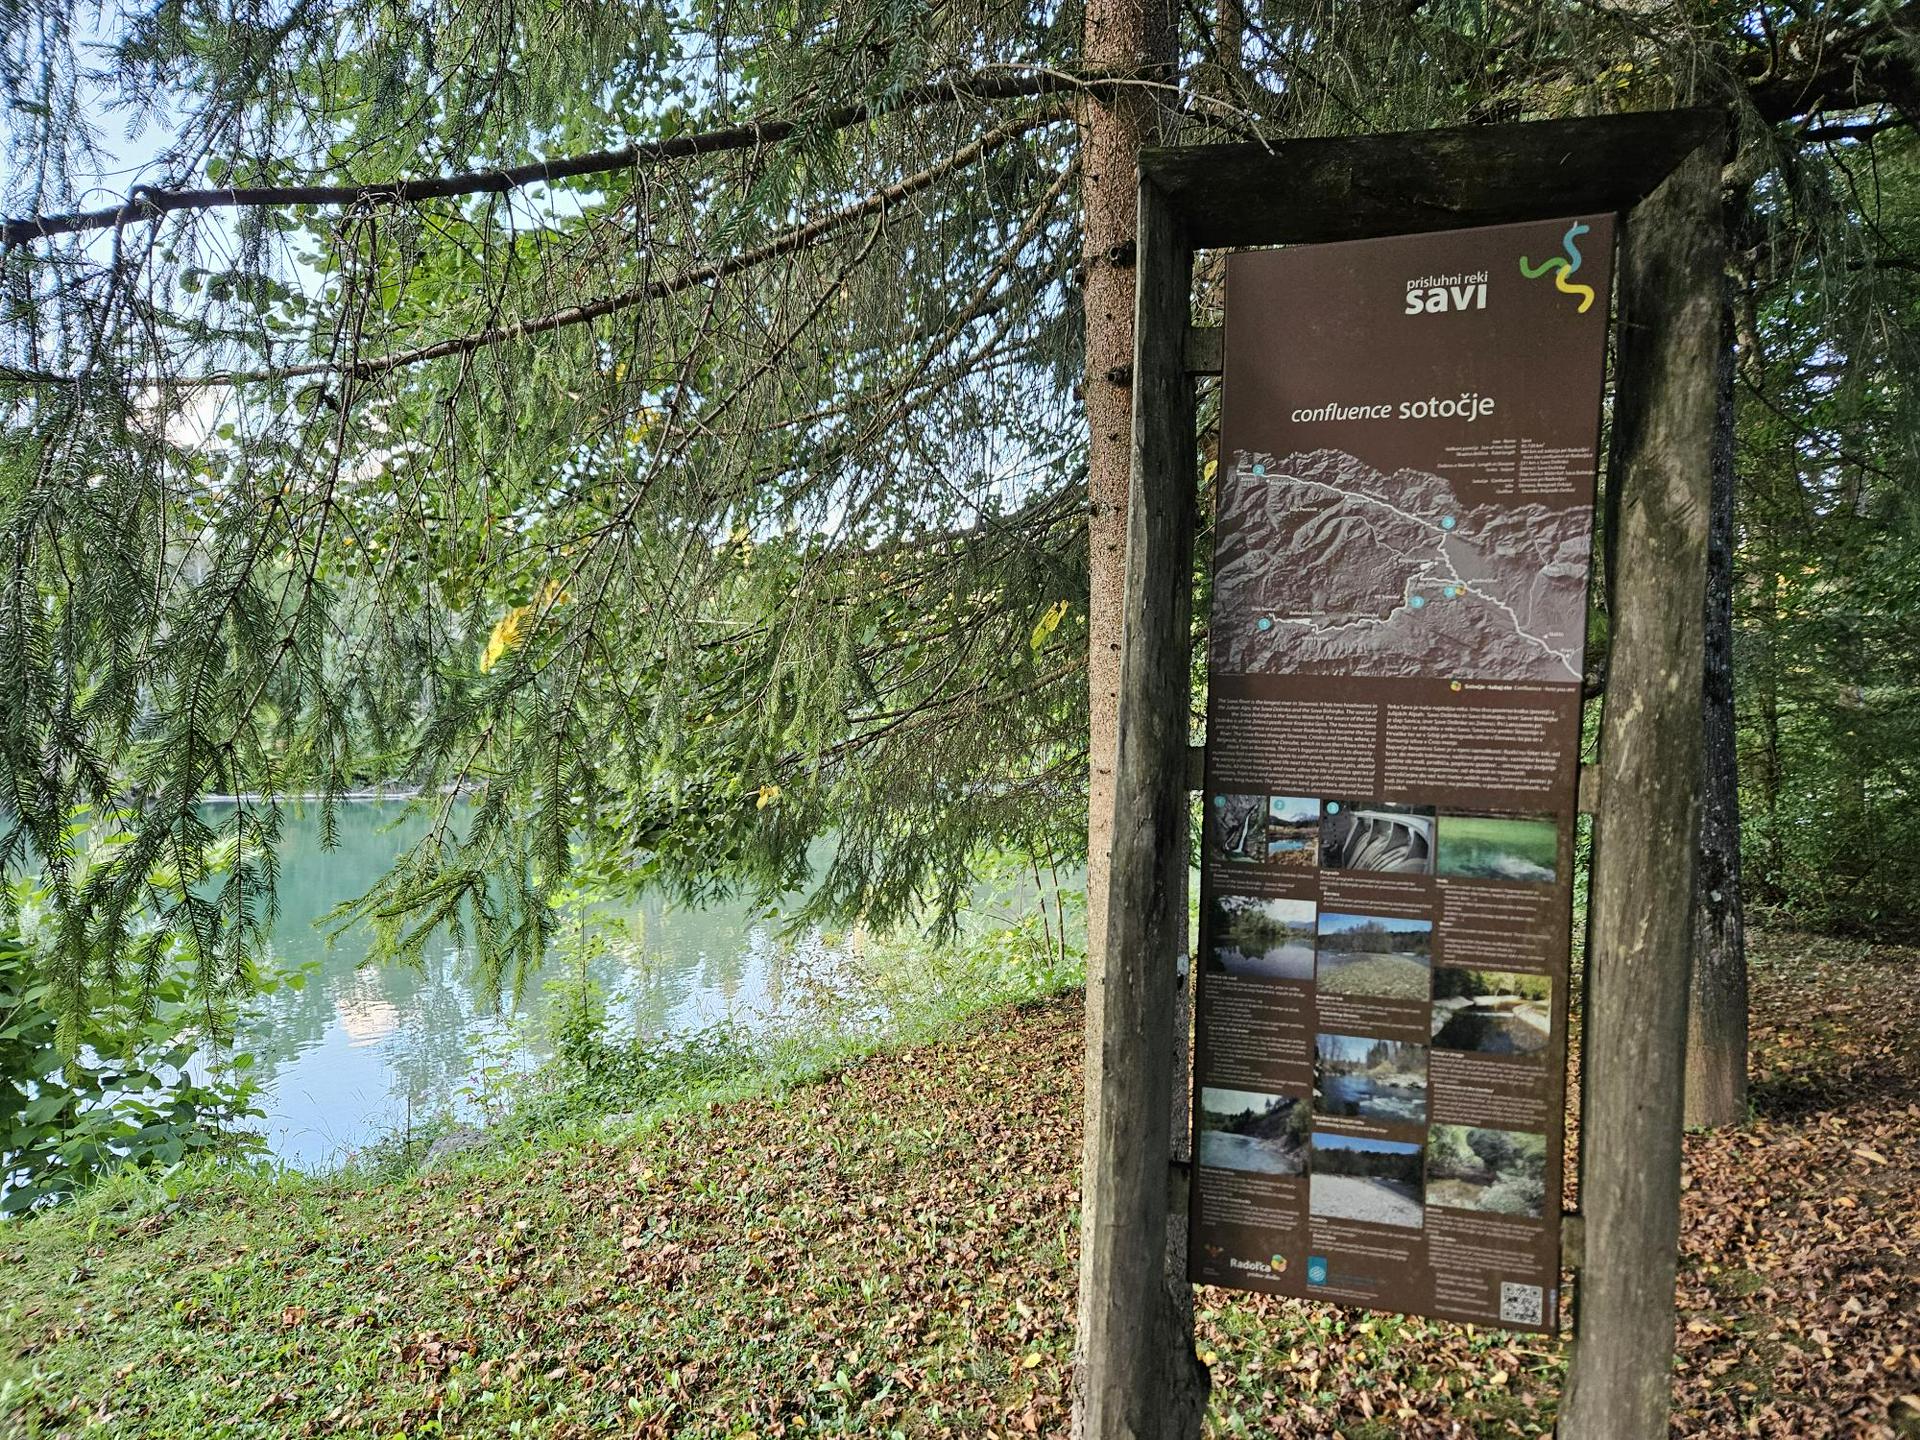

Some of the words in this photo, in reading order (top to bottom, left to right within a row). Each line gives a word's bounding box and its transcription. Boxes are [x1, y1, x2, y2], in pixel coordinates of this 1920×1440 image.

[1407, 273, 1461, 290] prisluhni
[1464, 272, 1488, 285] reki
[1405, 285, 1487, 314] savi
[1291, 402, 1392, 423] confluence
[1399, 393, 1495, 422] sotočje
